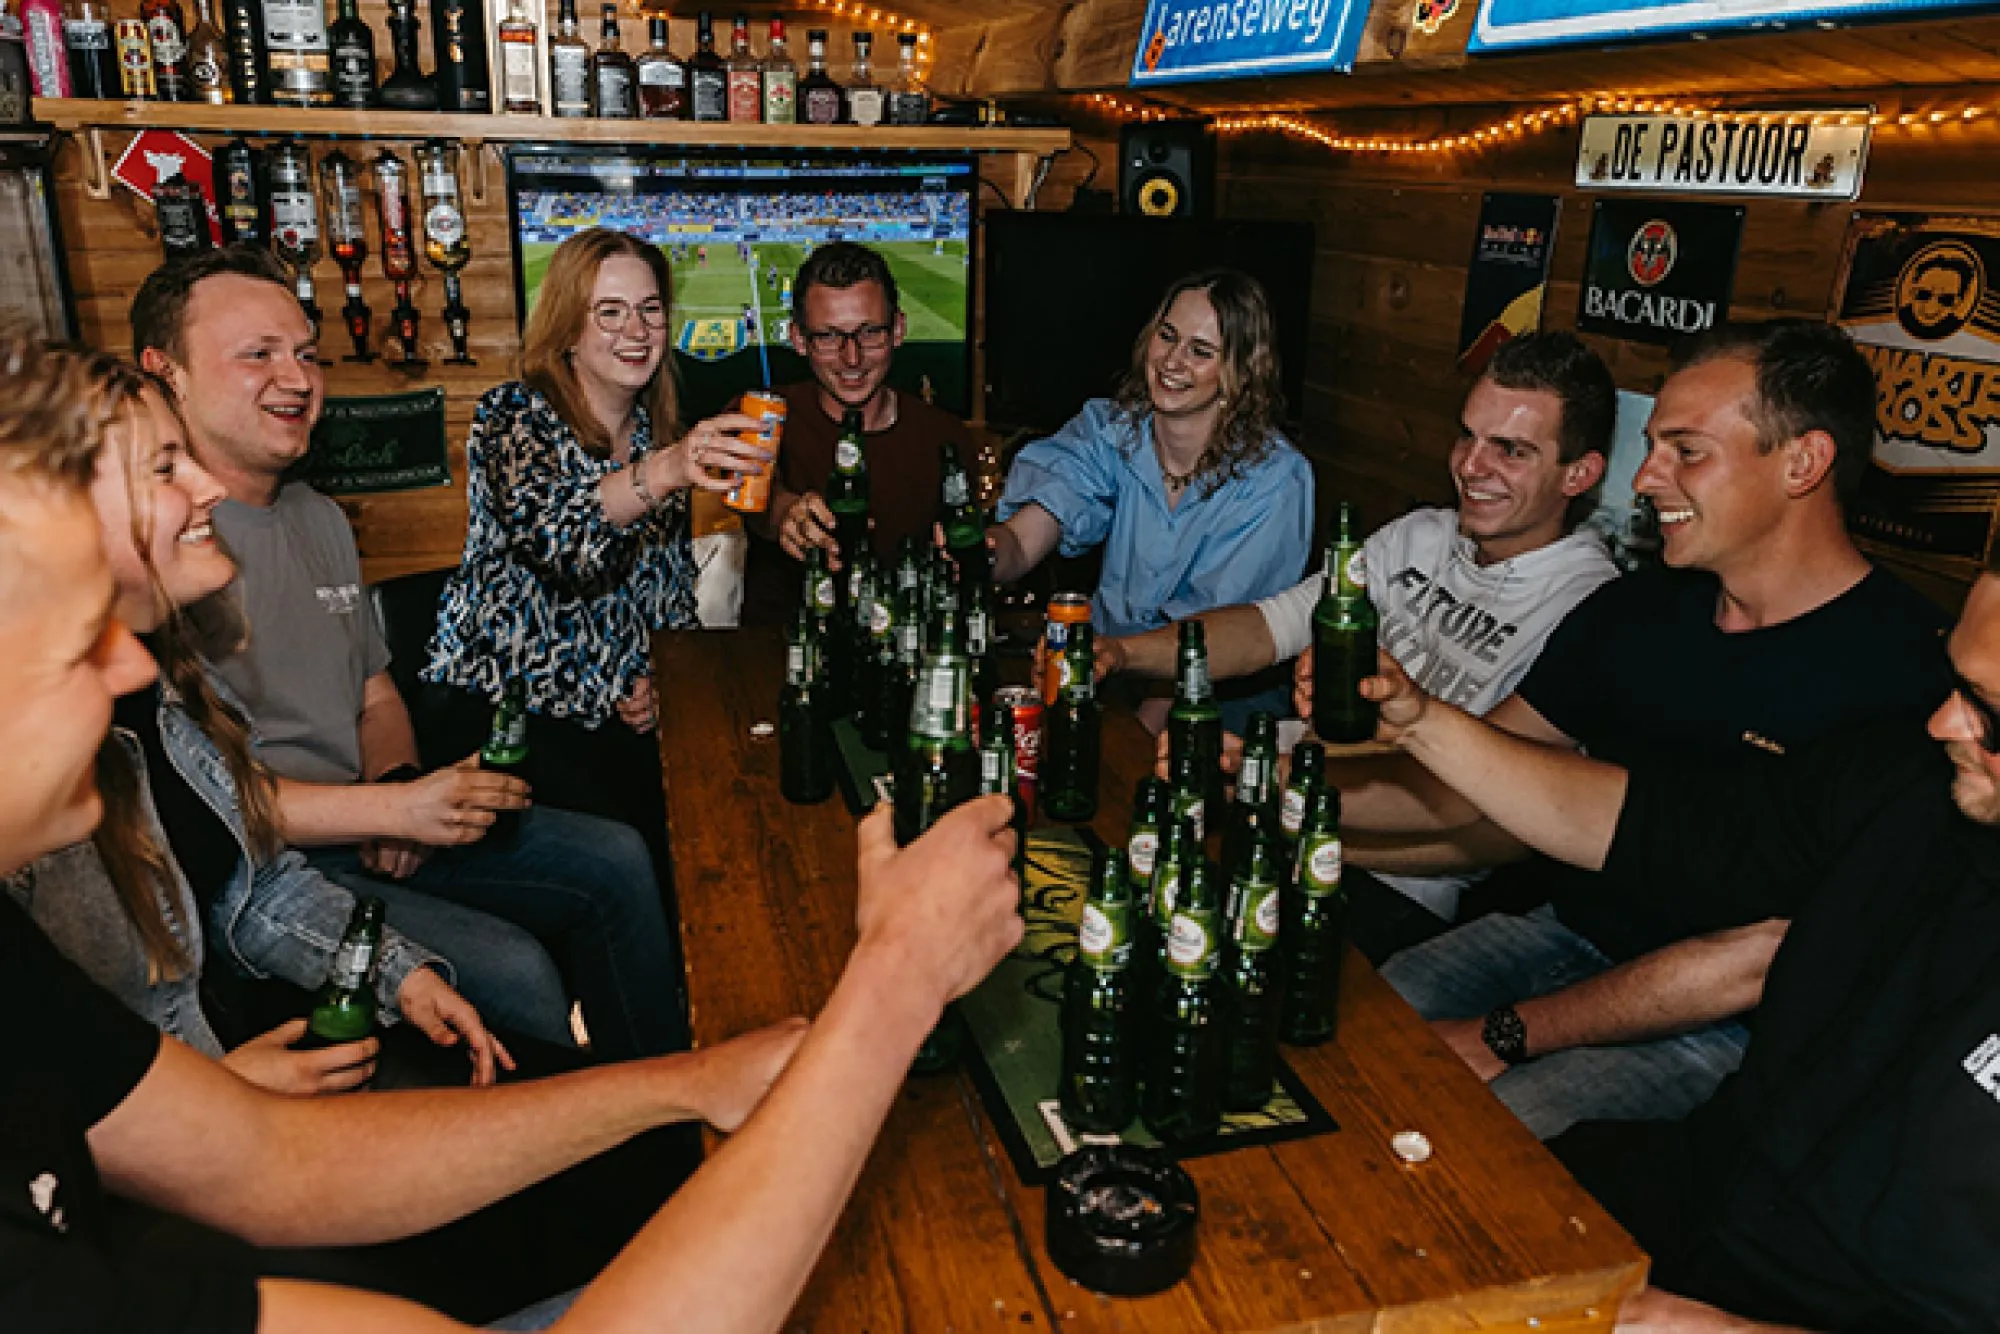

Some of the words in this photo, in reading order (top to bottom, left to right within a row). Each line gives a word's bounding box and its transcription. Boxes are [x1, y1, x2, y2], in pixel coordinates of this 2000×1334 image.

[1611, 123, 1648, 180] DE
[1654, 123, 1809, 187] PASTOOR
[1585, 286, 1717, 333] BACARDI
